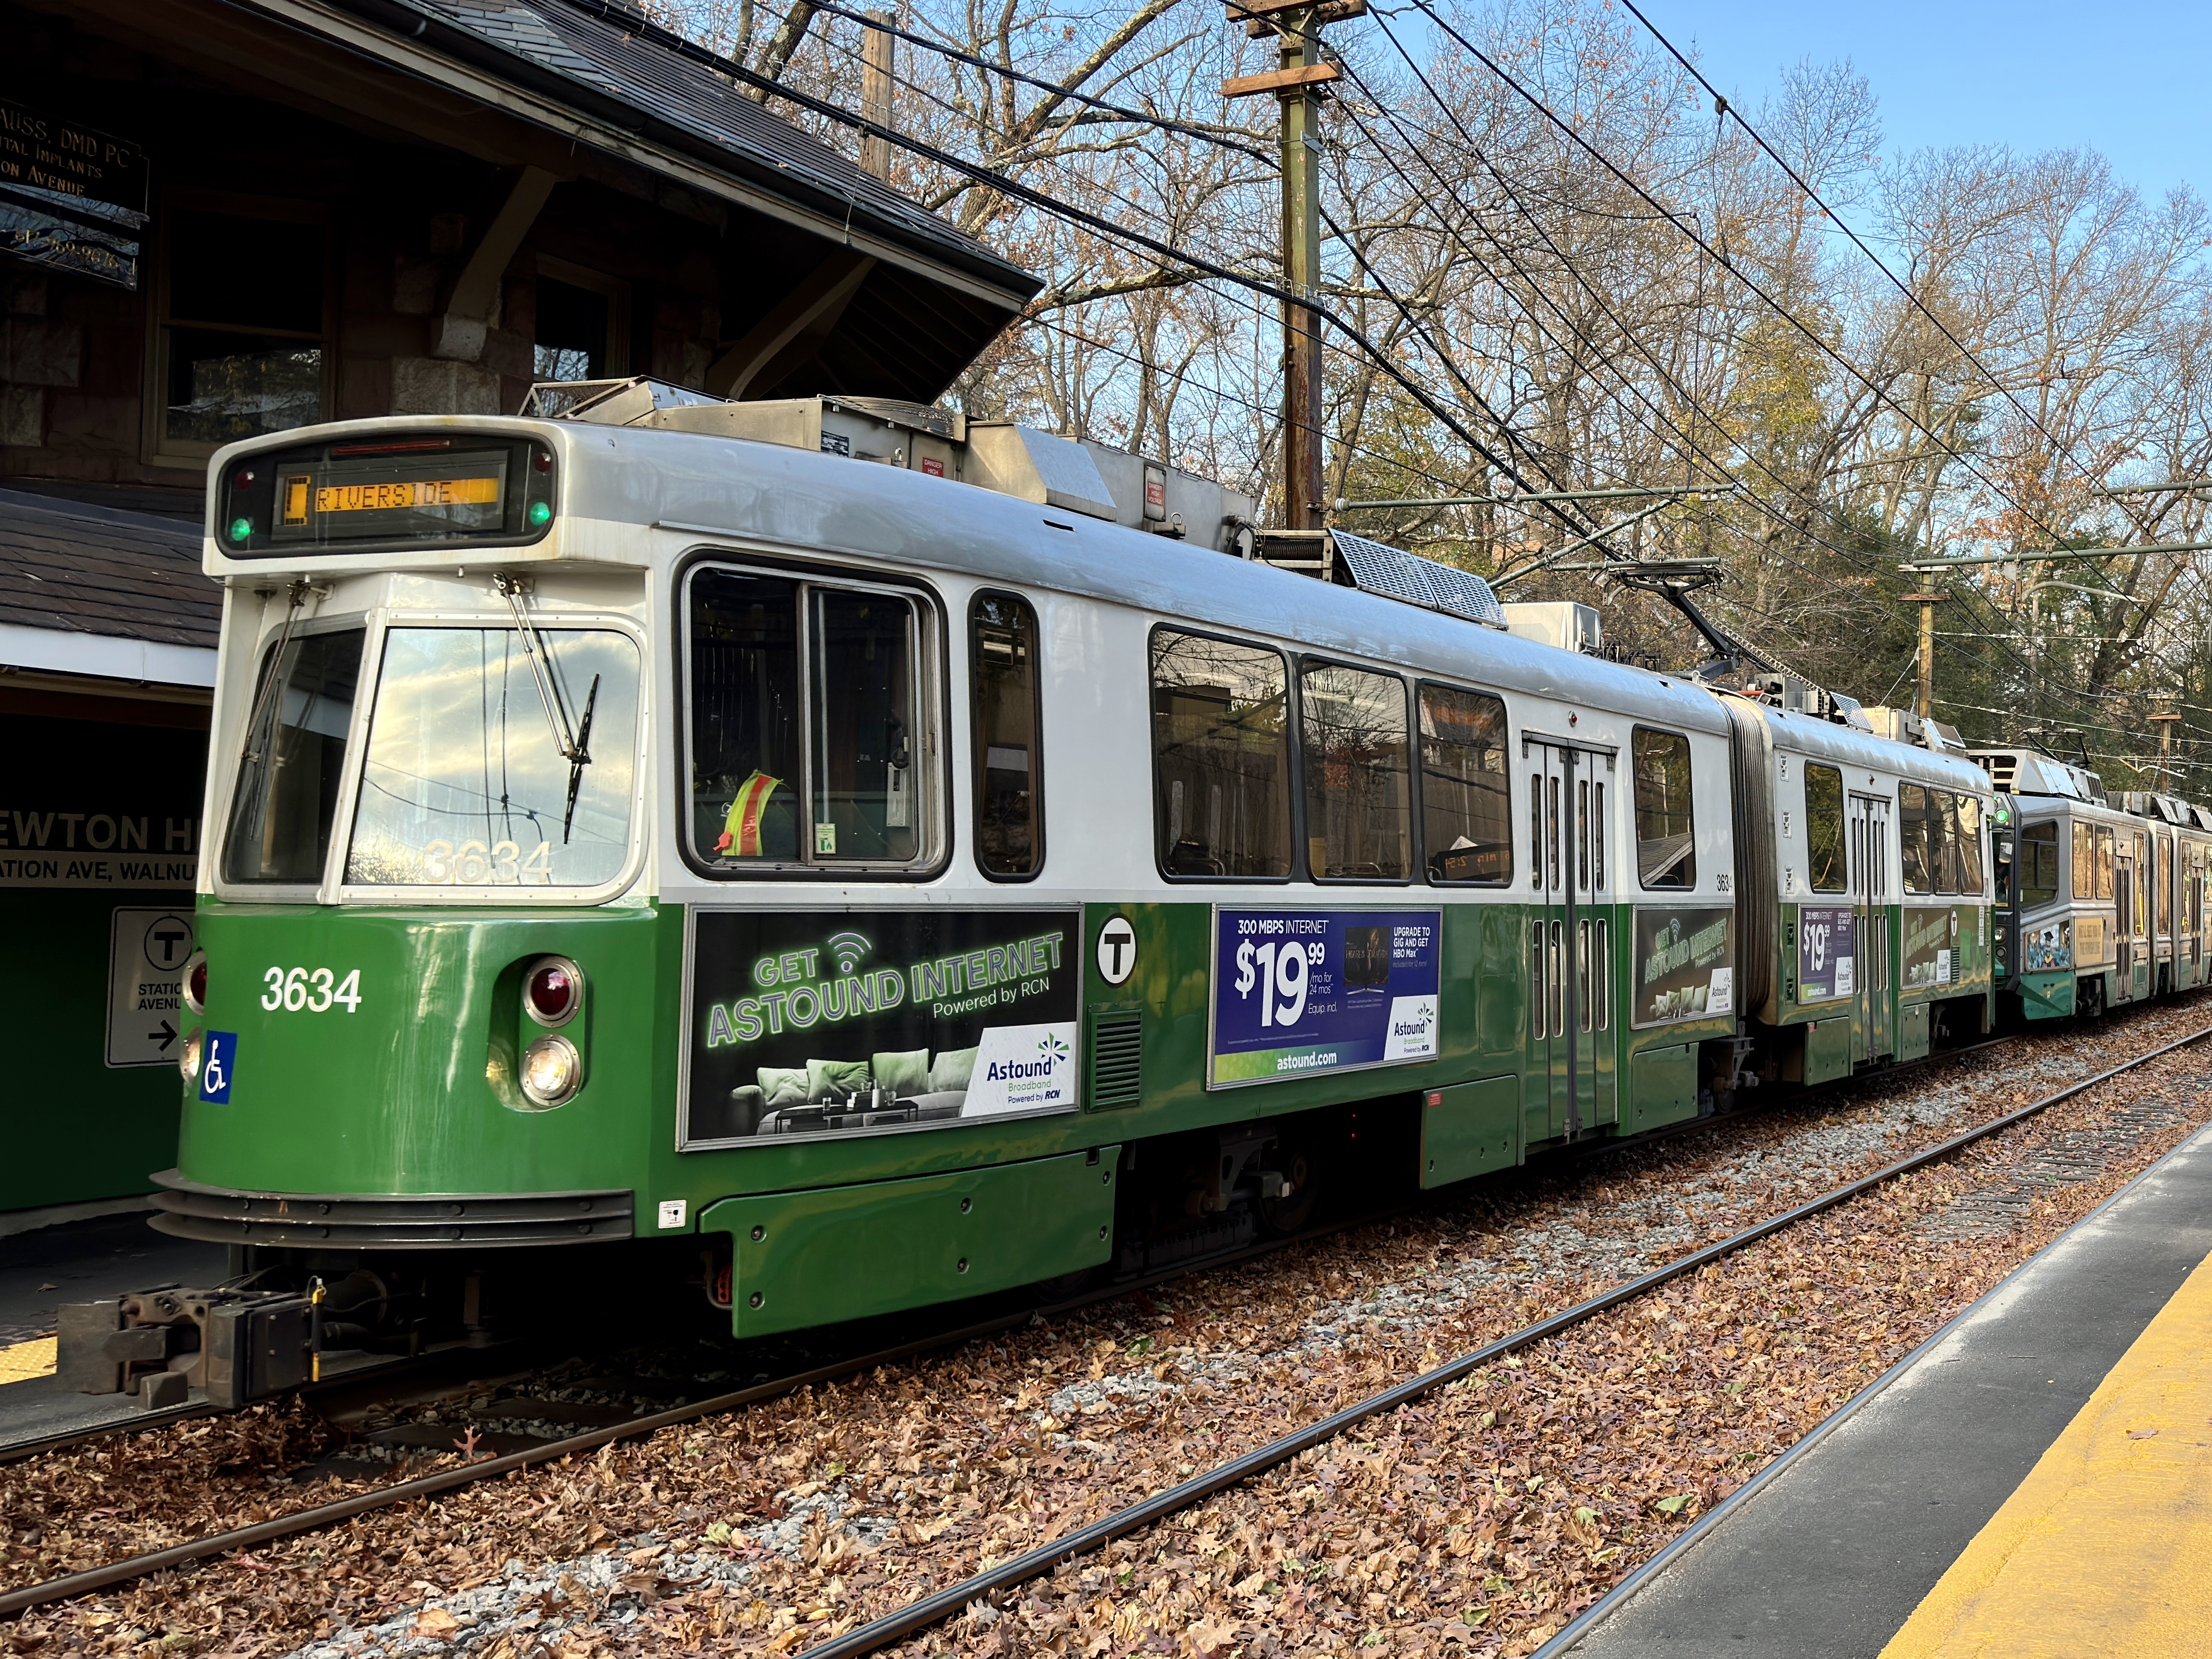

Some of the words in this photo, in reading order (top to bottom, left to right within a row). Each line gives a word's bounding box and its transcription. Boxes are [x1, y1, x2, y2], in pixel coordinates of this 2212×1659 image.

[0, 136, 29, 156] TAL
[36, 143, 102, 179] IMPLANTS
[61, 128, 97, 157] DMD
[106, 142, 130, 168] PC
[0, 160, 20, 177] ON
[27, 165, 85, 198] AVENUE
[924, 459, 942, 468] DANGER
[317, 482, 452, 511] RIVERSIDE
[0, 811, 148, 850] EWTON
[423, 839, 553, 884] 3634
[66, 861, 113, 882] AVE,
[1717, 874, 1732, 892] 3634
[1238, 920, 1257, 934] 300
[1259, 920, 1284, 934] MBPS
[1394, 927, 1421, 936] UPGRADE
[1422, 927, 1430, 936] TO
[154, 932, 185, 961] T
[1394, 938, 1404, 947] GIG
[1405, 938, 1417, 947] AND
[1418, 938, 1428, 947] GET
[1655, 927, 1669, 950] GET
[1105, 933, 1131, 975] T
[1393, 949, 1405, 958] HBO
[1645, 939, 1689, 985] ASTOUND
[1689, 918, 1727, 959] INTERNET
[1695, 952, 1711, 968] Powered
[1712, 951, 1716, 960] by
[754, 948, 819, 986] GET
[1838, 972, 1849, 981] Astound
[1310, 972, 1323, 984] /mo
[1324, 972, 1332, 982] for
[261, 967, 363, 1014] 3634
[707, 970, 904, 1048] ASTOUND
[911, 932, 1063, 1003] INTERNET
[933, 992, 997, 1019] Powered
[1001, 988, 1016, 1004] by
[1021, 977, 1050, 997] RCN
[1309, 985, 1317, 994] 24
[1712, 985, 1727, 997] Astound
[1308, 1003, 1325, 1015] Equip.
[1327, 1002, 1337, 1012] incl.
[1395, 1020, 1424, 1036] Astound
[987, 1056, 1052, 1081] Astound
[1277, 1052, 1337, 1070] astound.com
[1009, 1079, 1051, 1092] Broadband
[1008, 1094, 1034, 1104] Powered
[1036, 1093, 1043, 1101] by
[1045, 1090, 1061, 1099] RCN
